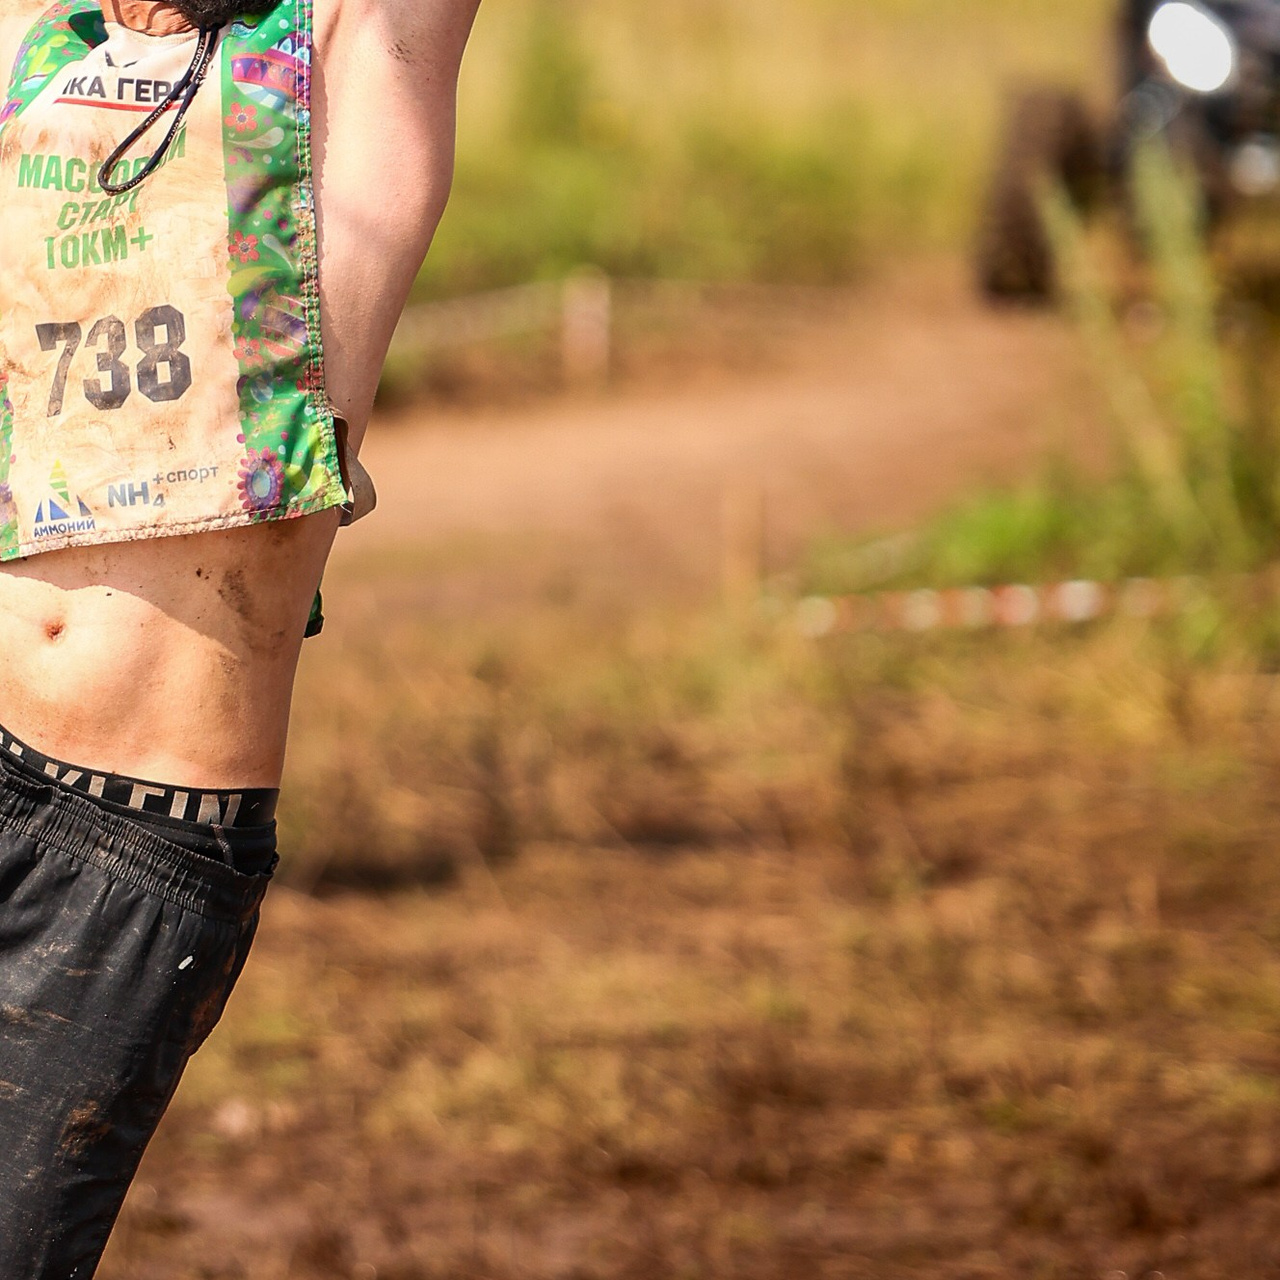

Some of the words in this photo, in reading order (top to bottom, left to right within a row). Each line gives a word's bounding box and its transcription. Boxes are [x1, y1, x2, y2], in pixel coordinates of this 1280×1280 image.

[62, 76, 107, 99] КА
[56, 184, 145, 230] СТАРТ
[35, 304, 192, 417] 738
[34, 515, 96, 538] АММОНИЙ
